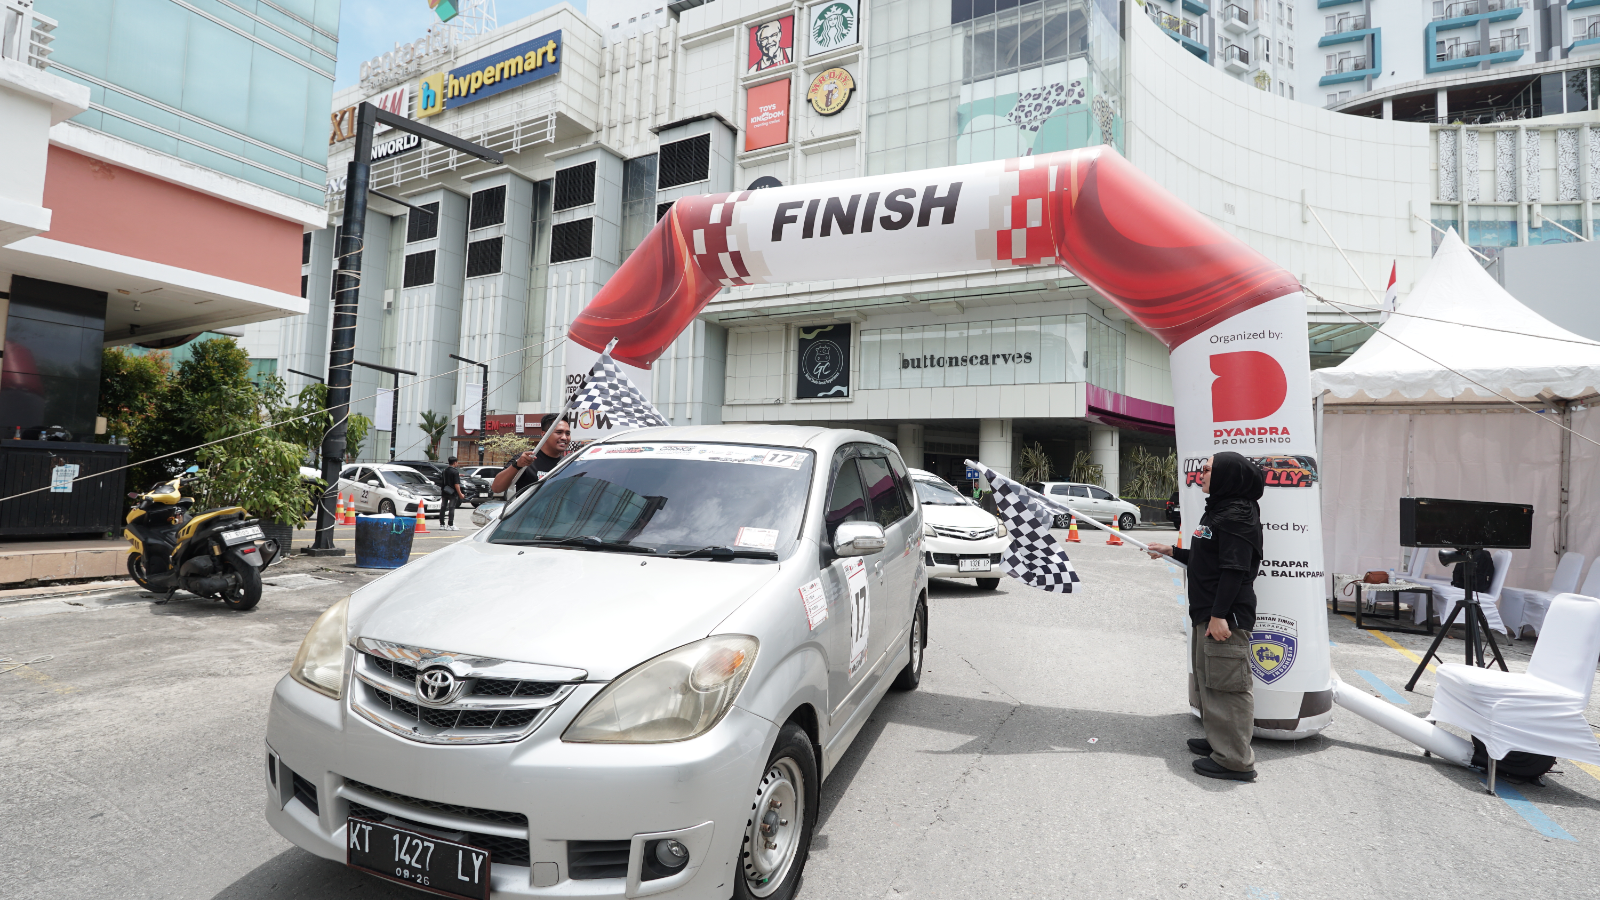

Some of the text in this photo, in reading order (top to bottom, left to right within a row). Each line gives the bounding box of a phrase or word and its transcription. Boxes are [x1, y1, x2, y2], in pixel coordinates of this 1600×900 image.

[447, 39, 557, 99] hypermart
[758, 103, 777, 113] TOYS
[771, 181, 963, 242] FINISH
[1209, 329, 1284, 344] Organized by:
[898, 351, 1034, 370] buttonscarves
[1213, 426, 1291, 439] DYANDRA
[1213, 436, 1291, 446] PROMOSINDO
[768, 453, 794, 464] 17
[361, 489, 369, 499] 22
[1292, 522, 1309, 534] by:
[855, 585, 867, 643] 17
[1272, 646, 1294, 678] INDONESIA
[350, 821, 484, 884] KT 1427 LY
